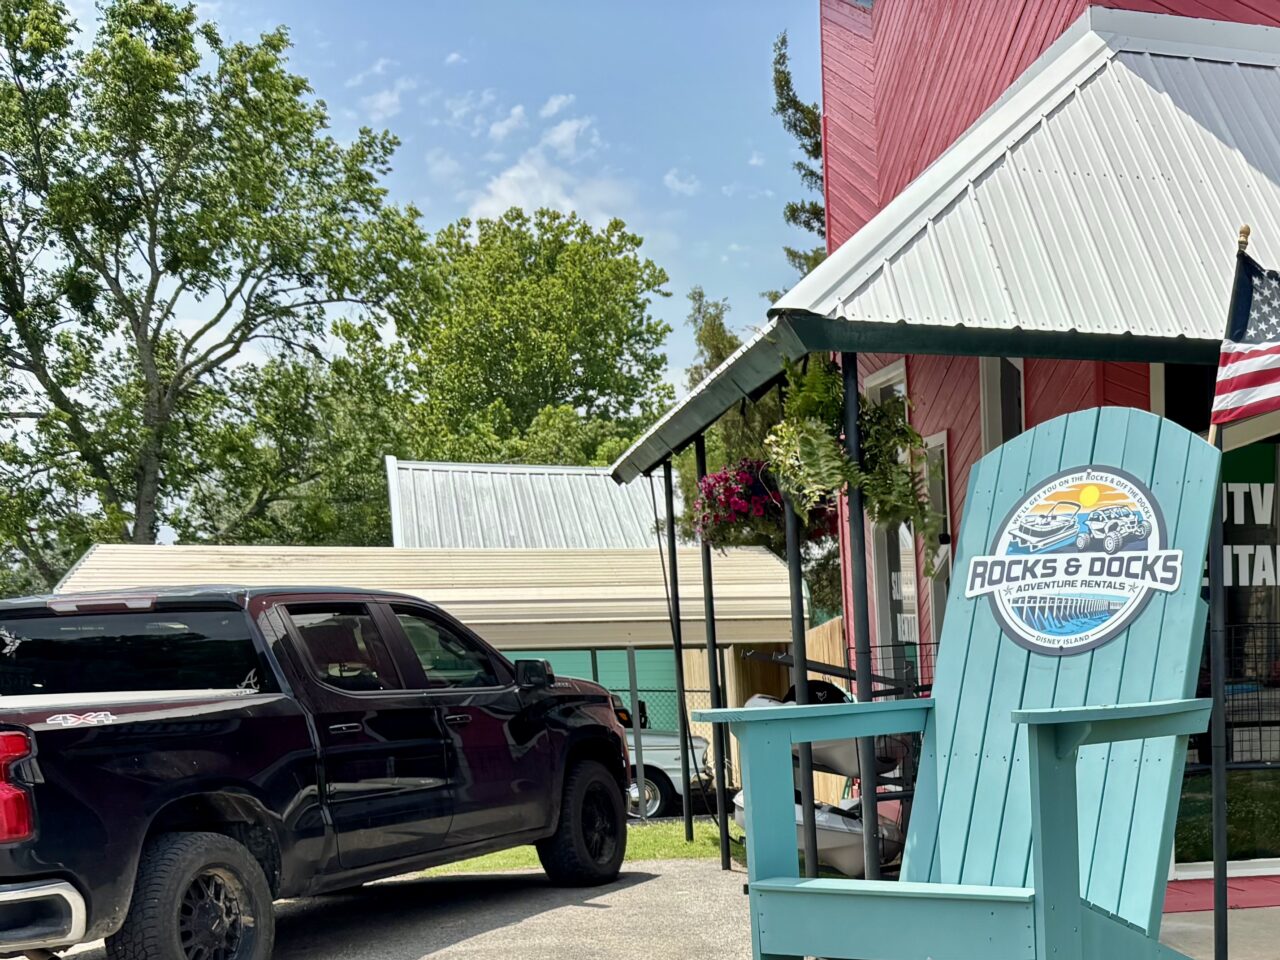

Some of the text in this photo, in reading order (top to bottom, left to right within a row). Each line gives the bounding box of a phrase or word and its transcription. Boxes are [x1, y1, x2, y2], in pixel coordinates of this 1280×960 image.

[1012, 507, 1029, 525] WE'LL
[1029, 494, 1041, 506] GET
[1042, 484, 1057, 496] YOU
[1071, 475, 1083, 483] THE
[1085, 474, 1108, 482] ROCKS
[1115, 480, 1128, 490] OFF
[1127, 487, 1139, 499] THE
[1137, 497, 1153, 520] DOCKS
[970, 555, 1180, 591] ROCKS & DOCKS
[1016, 580, 1126, 593] ADVENTURE RENTALS
[1036, 634, 1090, 645] DISNEY ISLAND
